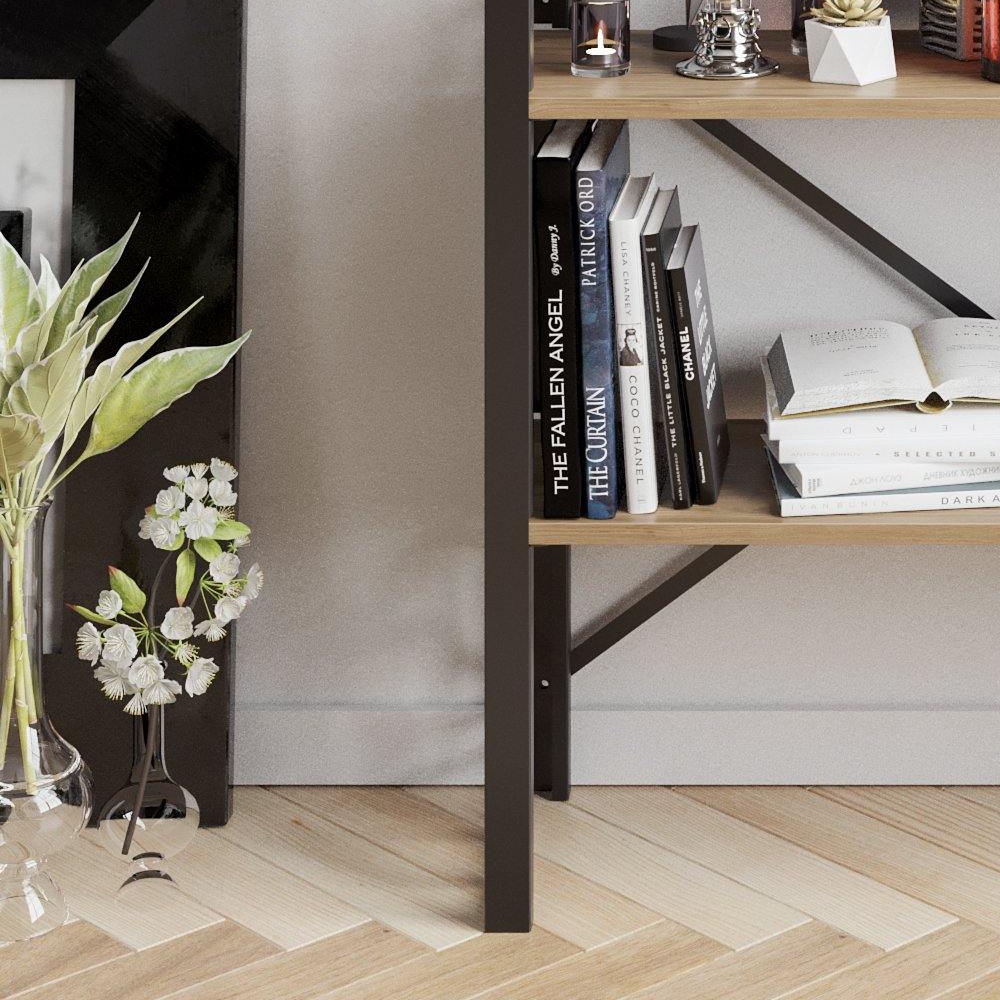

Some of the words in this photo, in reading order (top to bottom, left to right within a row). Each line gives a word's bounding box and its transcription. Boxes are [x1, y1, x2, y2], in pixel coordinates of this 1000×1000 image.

[578, 177, 594, 213] ORD
[549, 233, 561, 262] Danny
[581, 217, 596, 287] PATRICK
[620, 241, 628, 266] LISA
[551, 262, 563, 276] By
[622, 270, 632, 317] CHANEY
[548, 288, 564, 363] ANGEL
[656, 317, 666, 355] JACKET
[679, 326, 695, 381] CHANEL
[661, 358, 671, 390] BLACK
[550, 367, 566, 448] FALLEN
[628, 375, 640, 418] COCO
[665, 393, 675, 425] LITTLE
[585, 386, 608, 463] CURTAIN
[669, 427, 678, 448] THE
[632, 425, 644, 485] CHANEL
[893, 450, 977, 458] SELECTED
[552, 453, 569, 495] THE
[589, 465, 608, 500] THE
[941, 494, 985, 506] DARK
